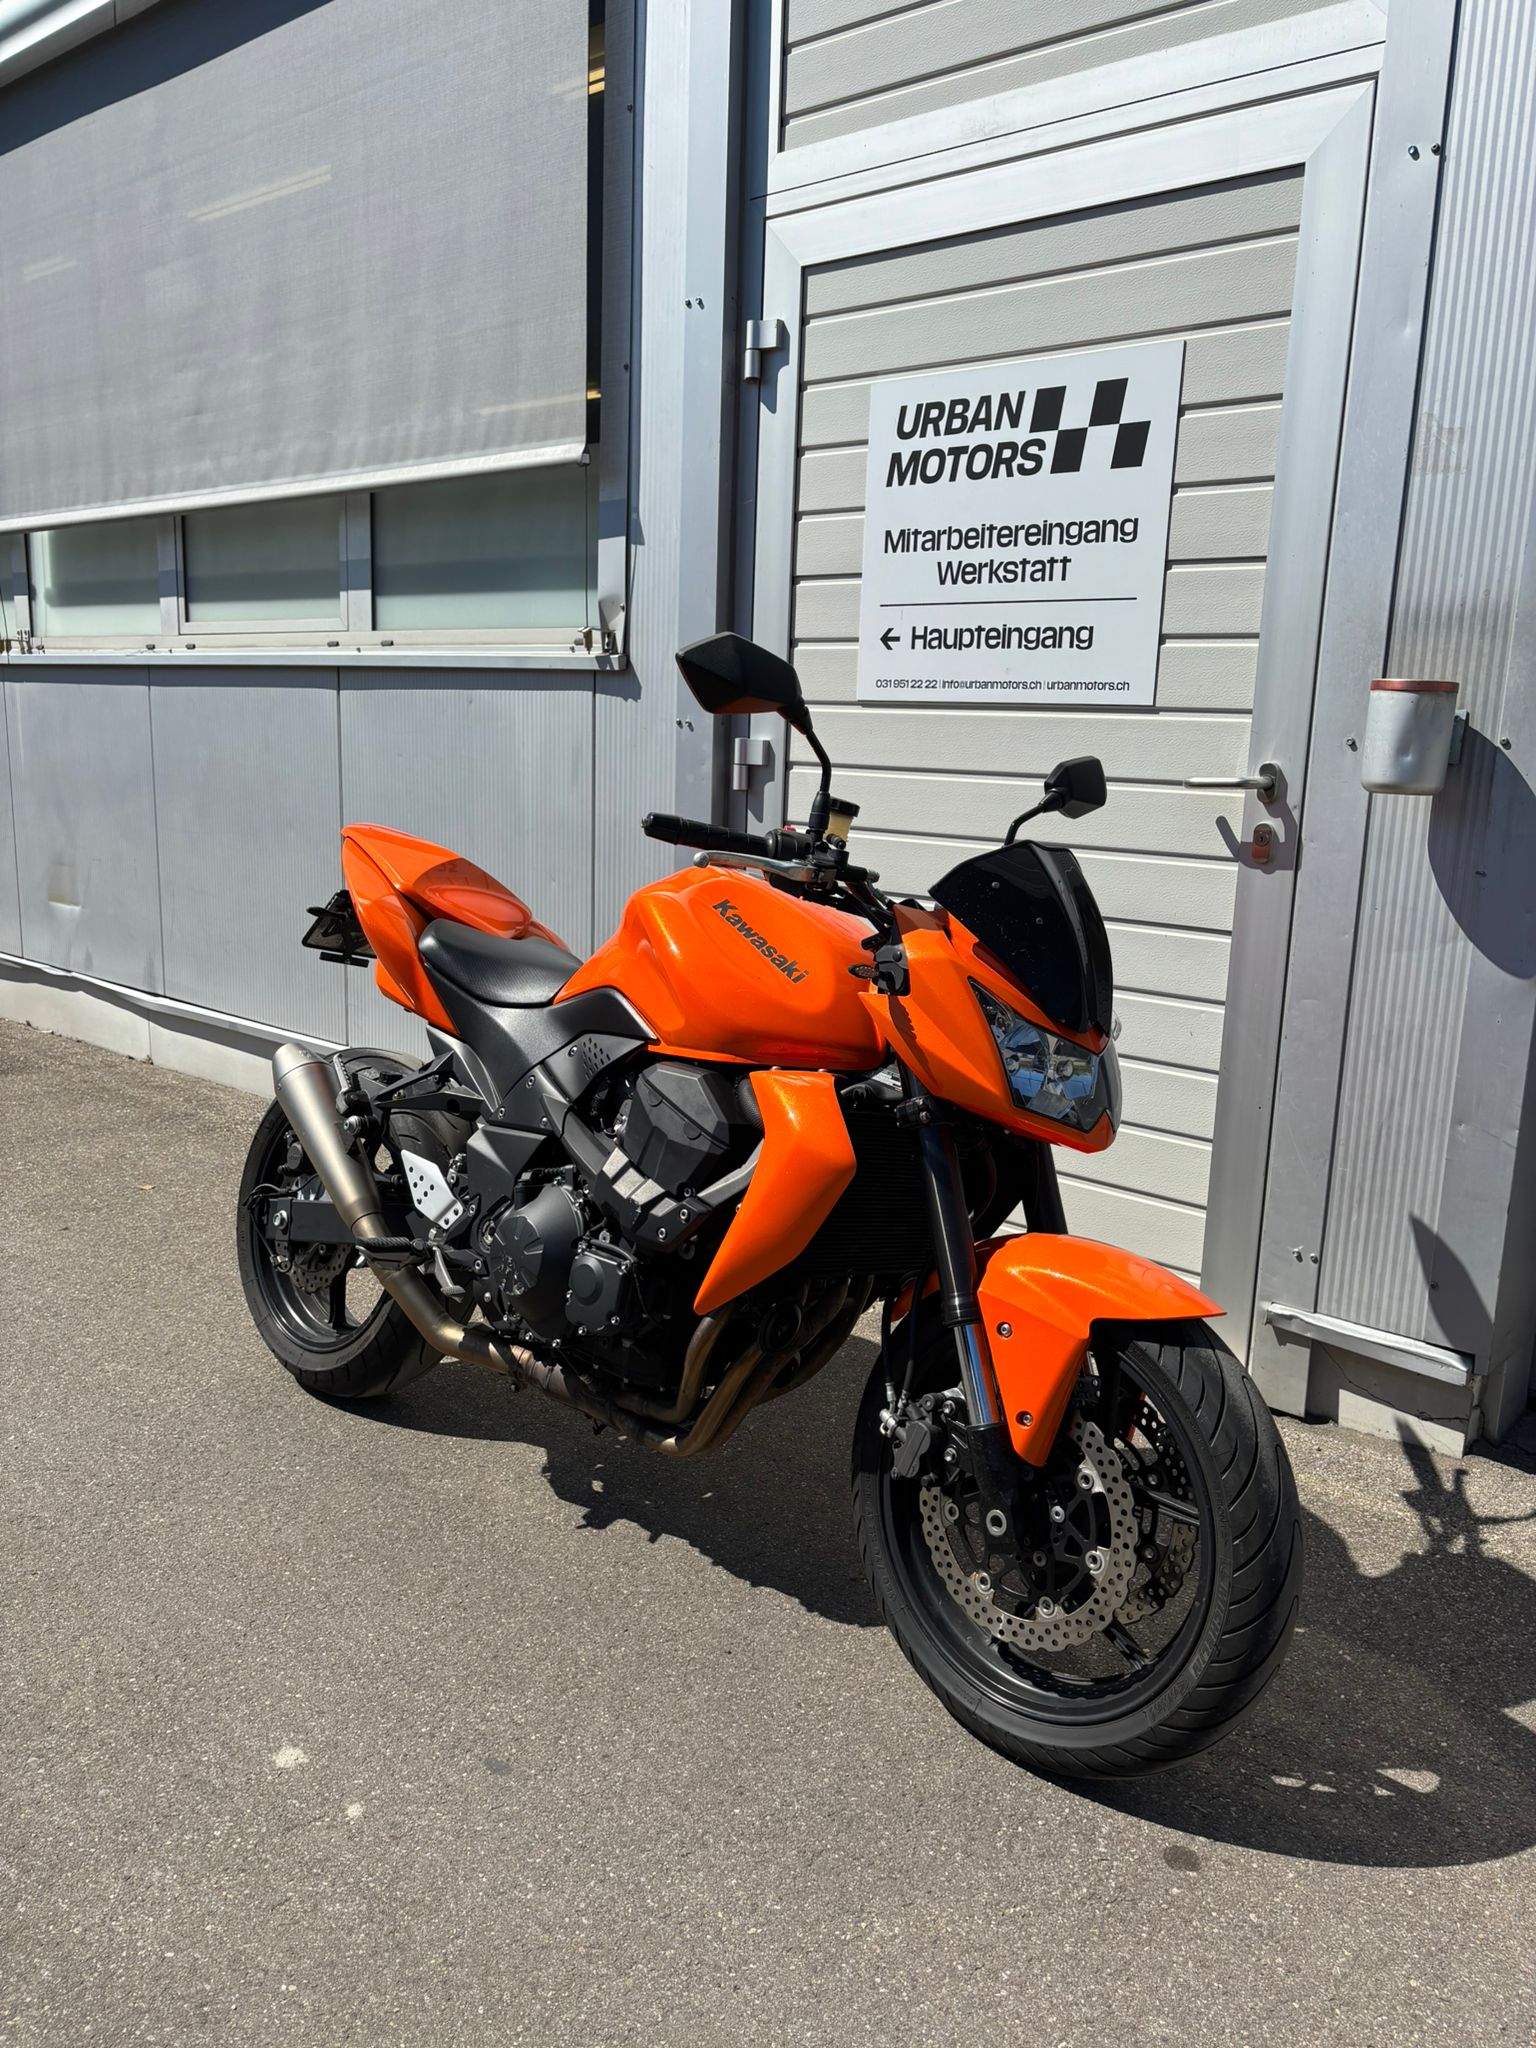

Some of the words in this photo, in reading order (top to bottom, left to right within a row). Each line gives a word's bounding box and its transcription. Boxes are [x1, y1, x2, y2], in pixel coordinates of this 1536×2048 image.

[896, 390, 1027, 441] URBAN
[885, 438, 1047, 488] MOTORS
[884, 517, 1140, 554] Mitarbeitereingang
[936, 555, 1072, 586] Werkstatt
[910, 623, 1095, 651] Haupteingang
[1046, 680, 1131, 692] urbanmotors.ch
[712, 899, 809, 984] Kawasaki
